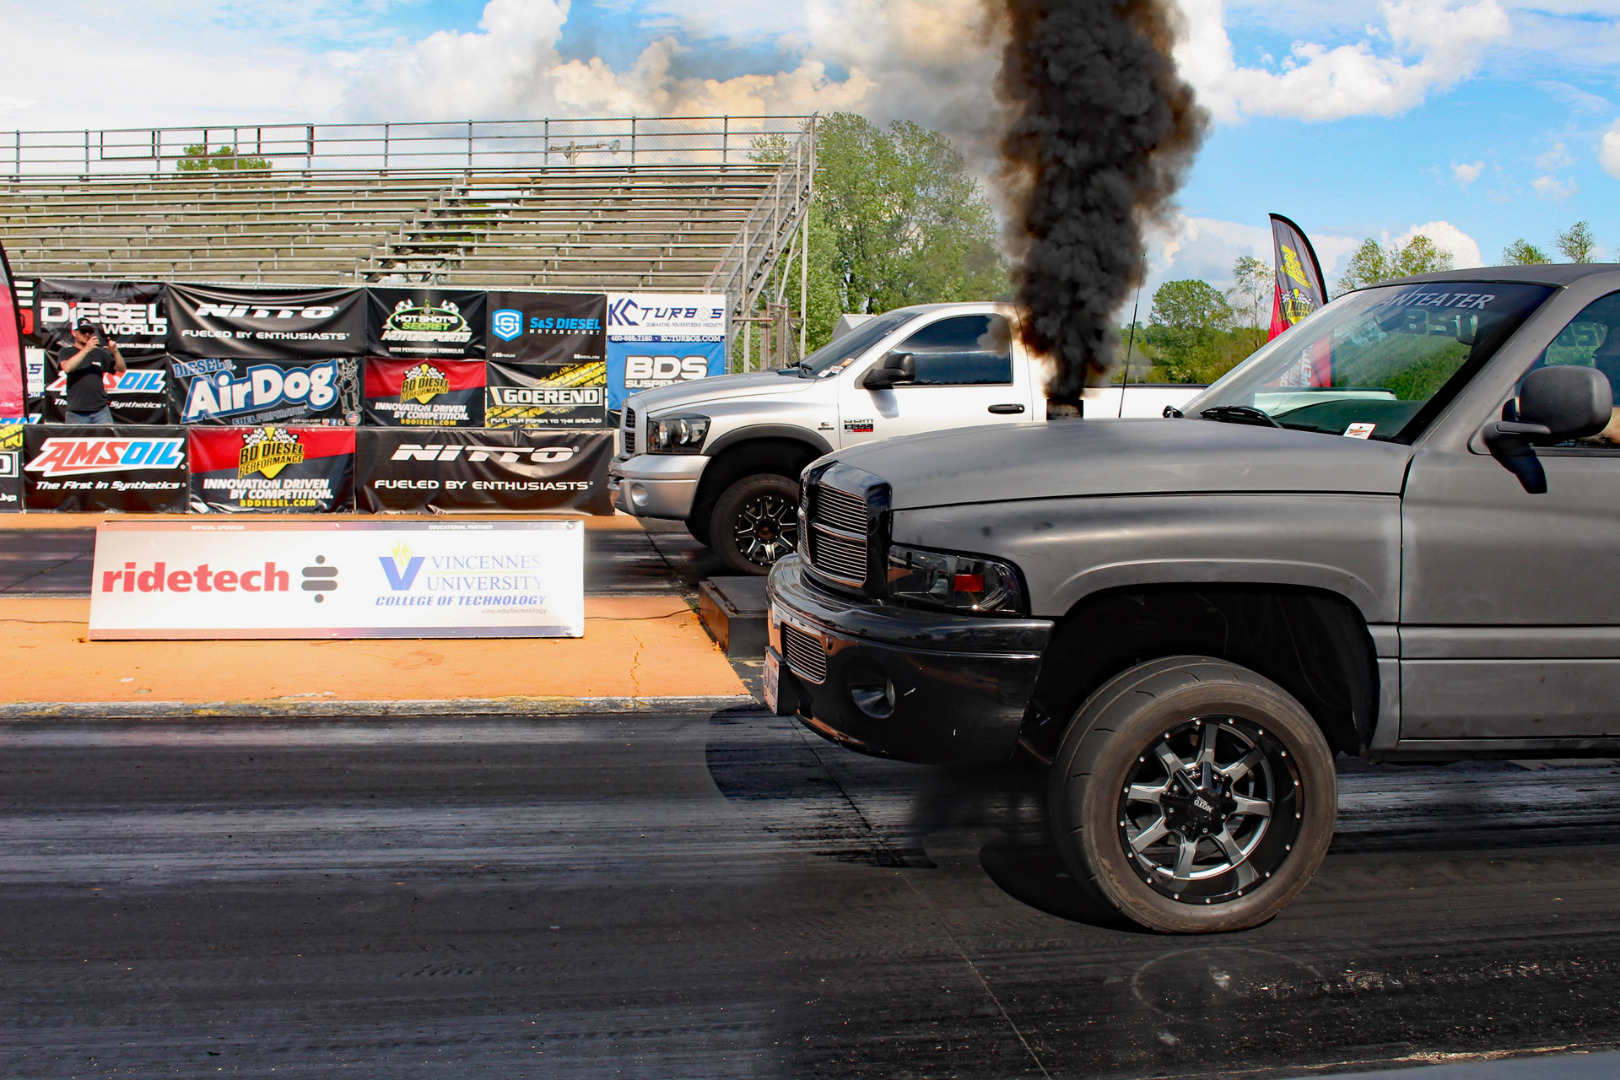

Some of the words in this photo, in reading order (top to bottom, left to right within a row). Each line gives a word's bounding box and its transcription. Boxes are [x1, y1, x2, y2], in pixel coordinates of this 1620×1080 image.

[1379, 293, 1496, 310] ANTEATER
[195, 303, 335, 318] NITTO
[608, 297, 640, 326] KC
[395, 315, 418, 323] HOT
[529, 317, 554, 329] S&S
[555, 317, 601, 330] DIESEL
[102, 323, 168, 336] WORLD
[402, 322, 452, 331] SECRET
[181, 329, 232, 338] FUELED
[236, 331, 252, 339] BY
[256, 332, 347, 340] ENTHUSIASTS
[173, 358, 224, 378] DIESEL
[625, 355, 708, 380] BDS
[186, 364, 336, 418] AirDog
[401, 379, 416, 391] BD
[418, 377, 449, 388] DIESEL
[400, 387, 449, 403] PERFORMANCE
[503, 389, 598, 403] GOEREND
[110, 400, 162, 409] Synthetics
[374, 402, 432, 412] INNOVATION
[432, 404, 467, 413] DRIVEN
[232, 415, 256, 426] FUEL
[393, 411, 406, 419] BY
[407, 411, 470, 420] COMPETITION.
[34, 441, 180, 473] AMSOIL
[239, 446, 259, 464] BD
[261, 442, 304, 456] DIESEL
[390, 444, 574, 463] NITTO
[238, 454, 304, 478] PERFORMANCE
[36, 481, 61, 490] The
[62, 481, 93, 490] First
[111, 481, 180, 492] Synthetics
[203, 478, 281, 489] INNOVATION
[282, 478, 329, 489] DRIVEN
[374, 480, 440, 489] FUELED
[445, 480, 467, 490] BY
[472, 481, 589, 491] ENTHUSIASTS
[229, 489, 246, 499] BY
[248, 489, 334, 499] COMPETITION.
[432, 555, 542, 570] VINCENNES
[102, 561, 290, 593] ridetech
[427, 575, 542, 591] UNIVERSITY
[375, 596, 433, 606] COLLEGE
[437, 596, 454, 605] OF
[458, 595, 547, 605] TECHNOLOGY
